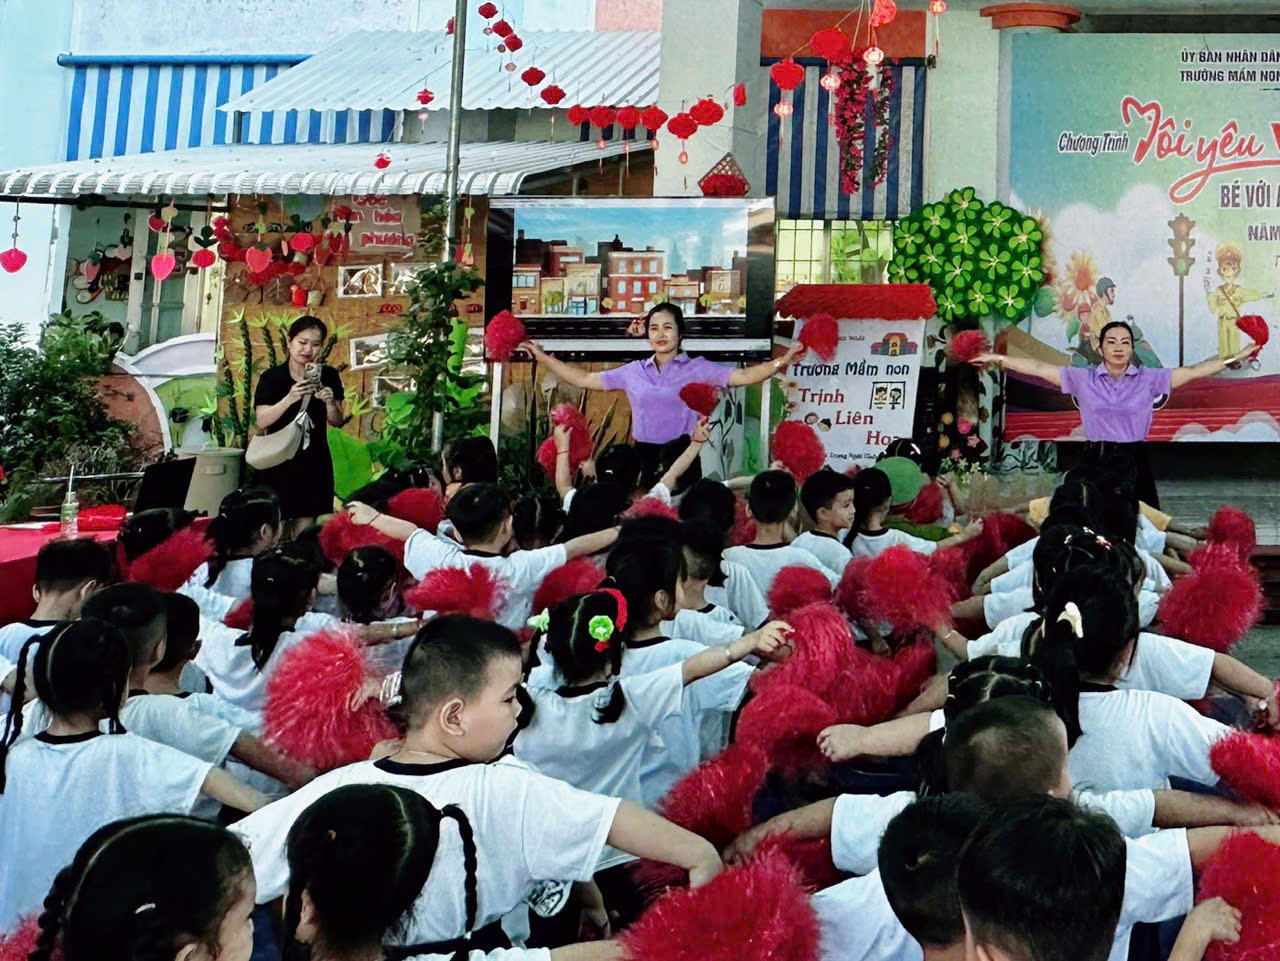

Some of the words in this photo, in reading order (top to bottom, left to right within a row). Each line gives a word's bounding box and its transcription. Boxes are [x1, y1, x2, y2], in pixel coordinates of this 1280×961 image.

[1200, 50, 1222, 62] BAN
[1226, 49, 1257, 62] NHÂN
[1059, 132, 1099, 155] Chương
[1102, 133, 1129, 152] Trình
[1186, 120, 1265, 190] yêu
[1220, 179, 1241, 208] BÉ
[1246, 179, 1271, 208] VỚI
[886, 365, 910, 375] non
[799, 388, 845, 406] Trịnh
[835, 410, 874, 425] Liên
